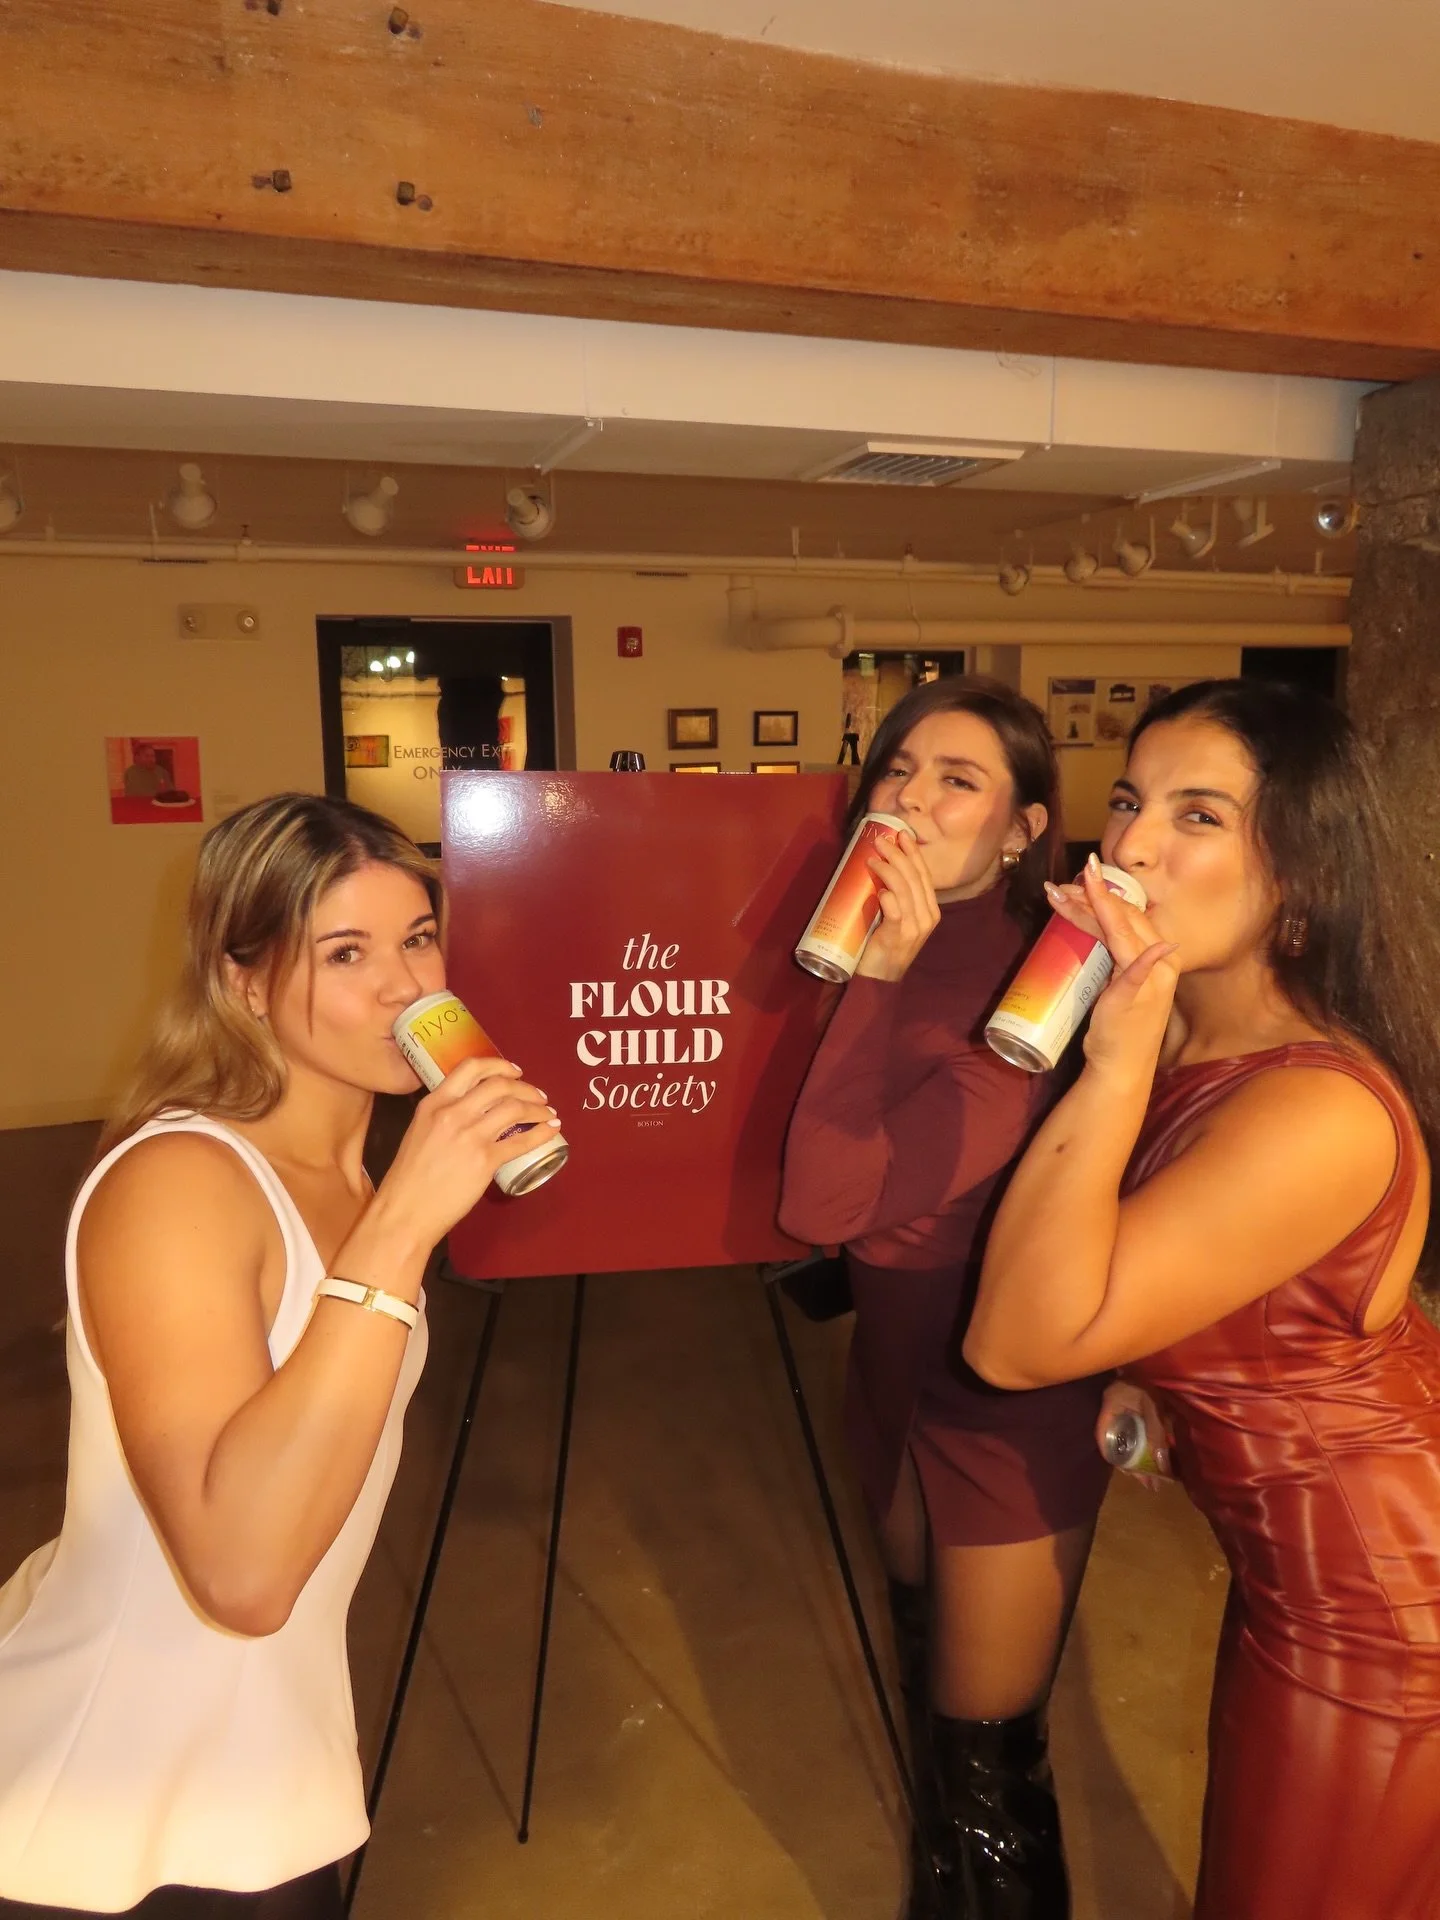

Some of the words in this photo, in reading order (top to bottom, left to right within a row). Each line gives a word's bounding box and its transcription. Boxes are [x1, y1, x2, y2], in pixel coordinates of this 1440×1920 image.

[394, 745, 475, 759] EMERGENCY
[413, 765, 461, 780] ON
[622, 932, 680, 971] the
[568, 979, 731, 1019] FLOUR
[407, 1009, 458, 1048] hiyo
[576, 1027, 724, 1067] CHILD
[582, 1072, 717, 1114] Society
